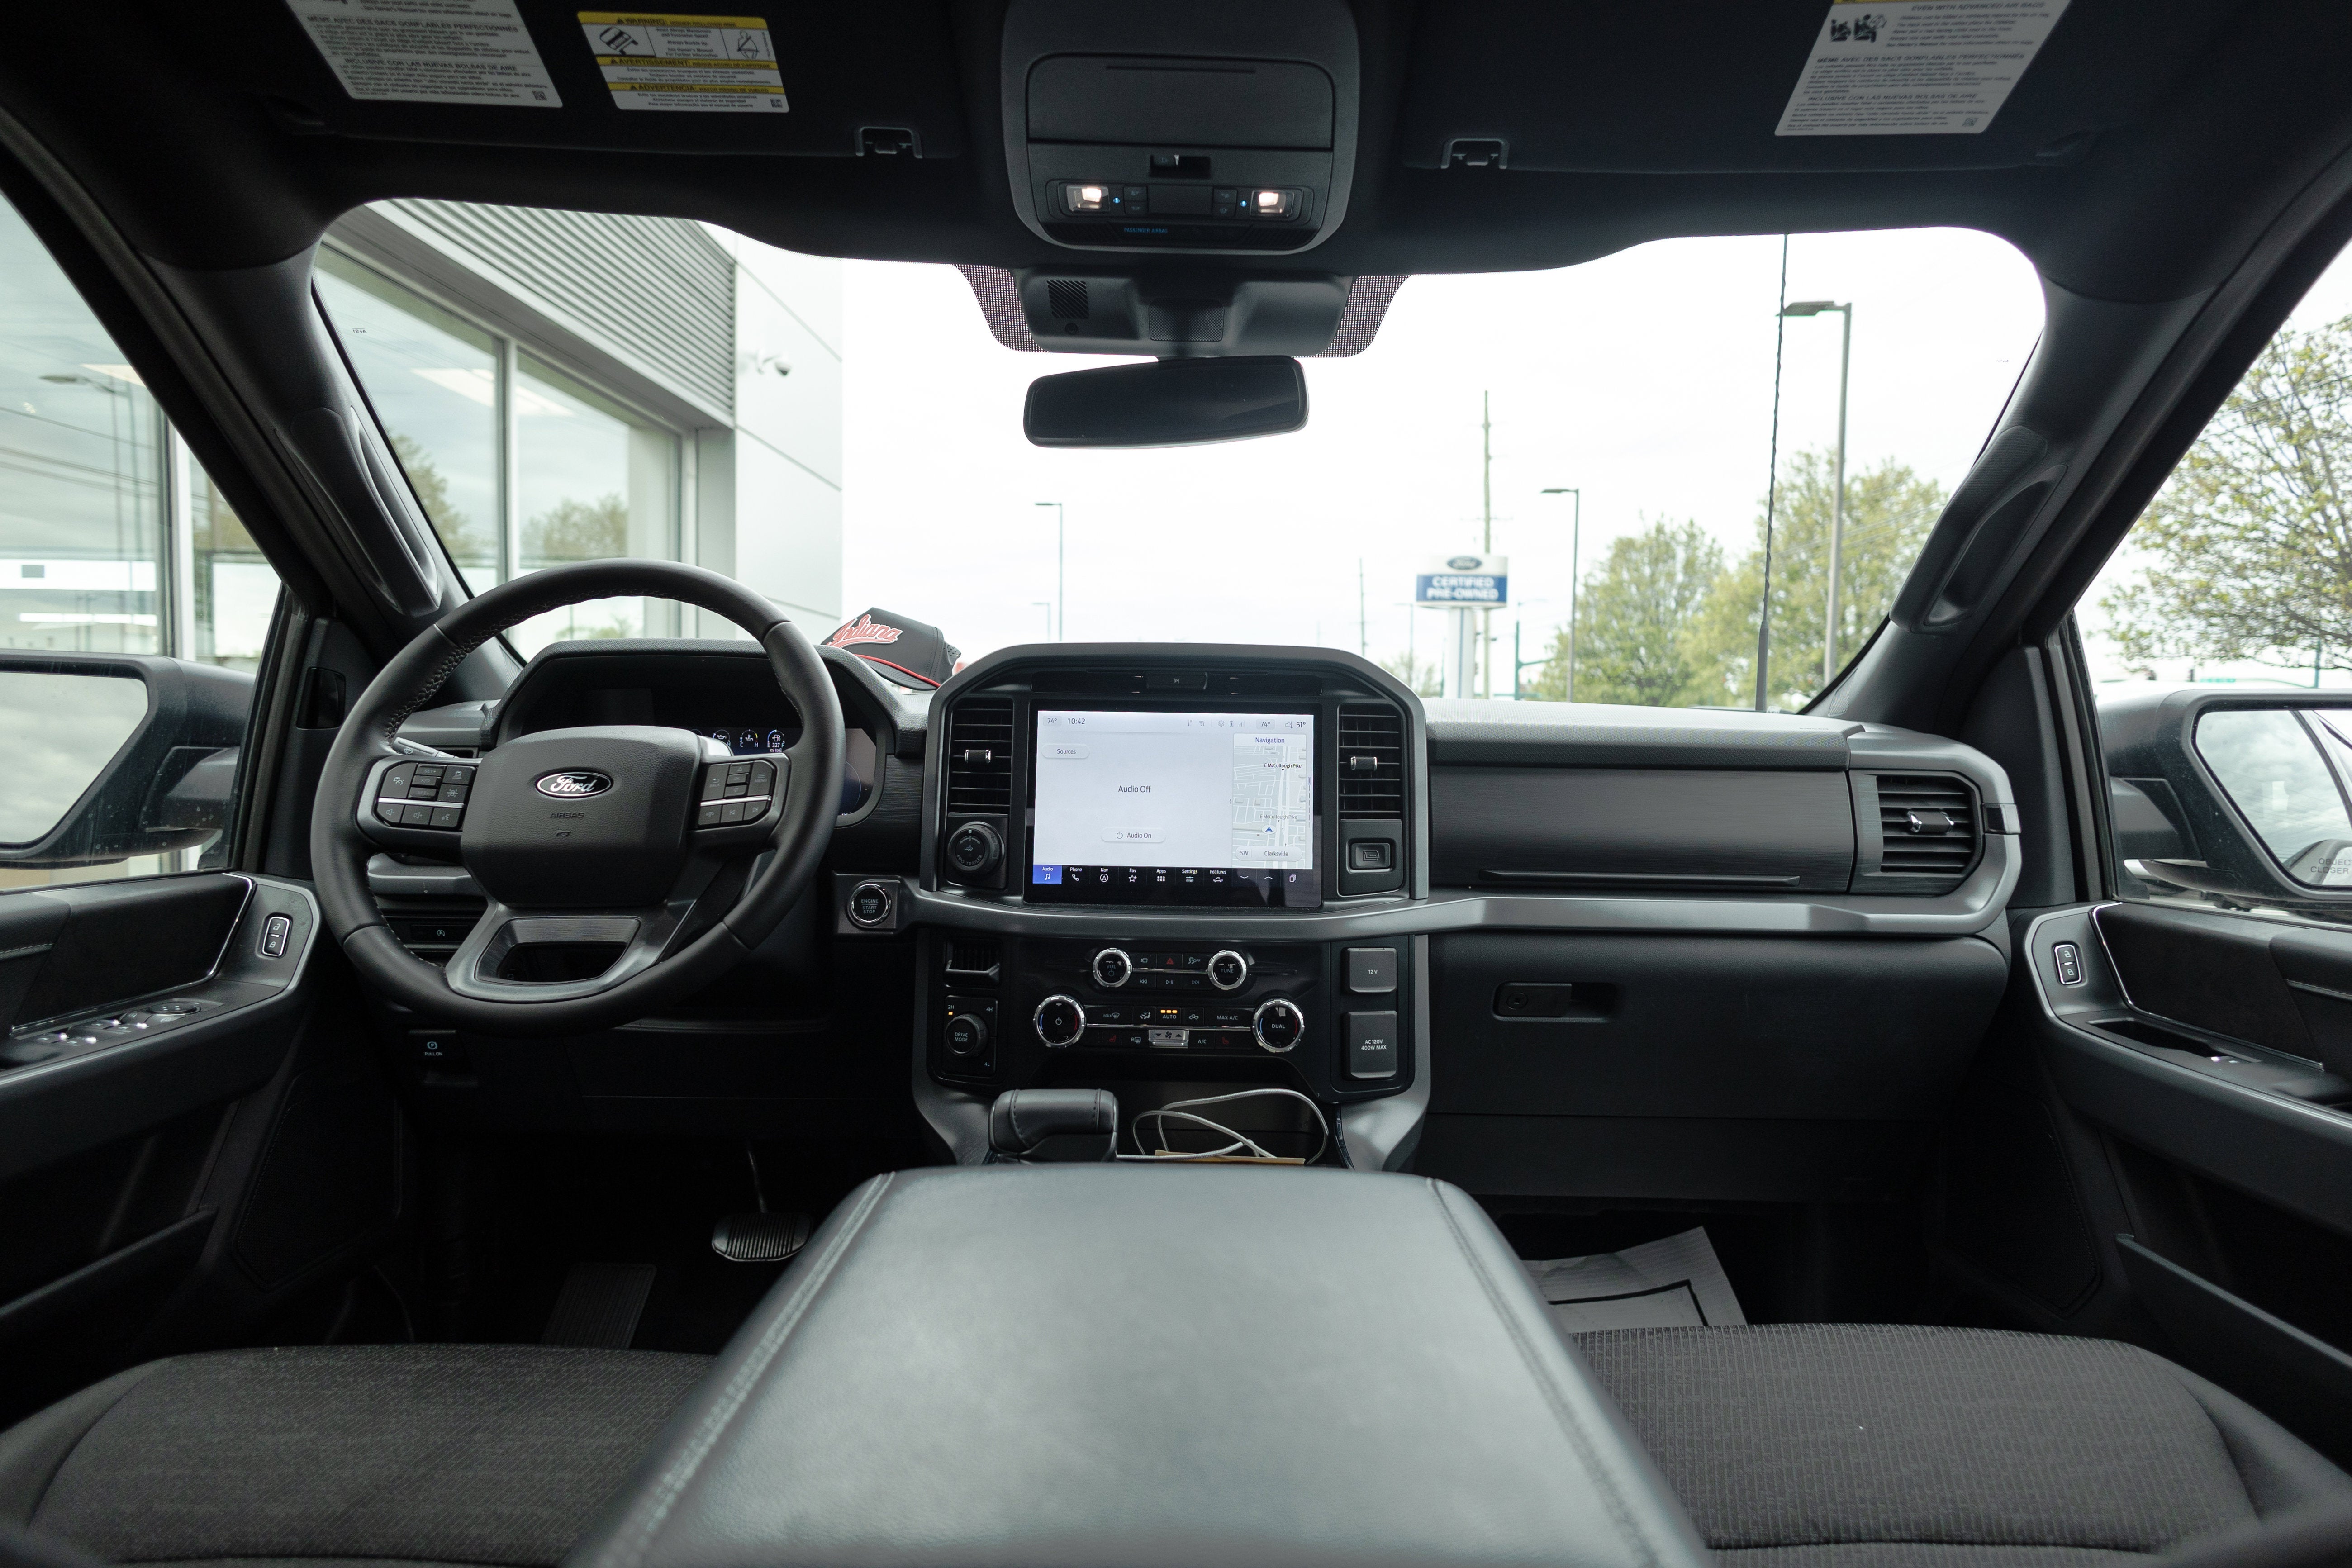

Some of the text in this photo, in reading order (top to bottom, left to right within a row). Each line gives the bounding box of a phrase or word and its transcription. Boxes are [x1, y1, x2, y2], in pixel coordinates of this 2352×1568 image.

[1432, 576, 1494, 588] CERTIFIED
[1427, 588, 1499, 600] PRE-OWNED
[828, 614, 903, 644] Indiana
[550, 775, 598, 792] Ford
[956, 854, 983, 866] PRO TRAILER
